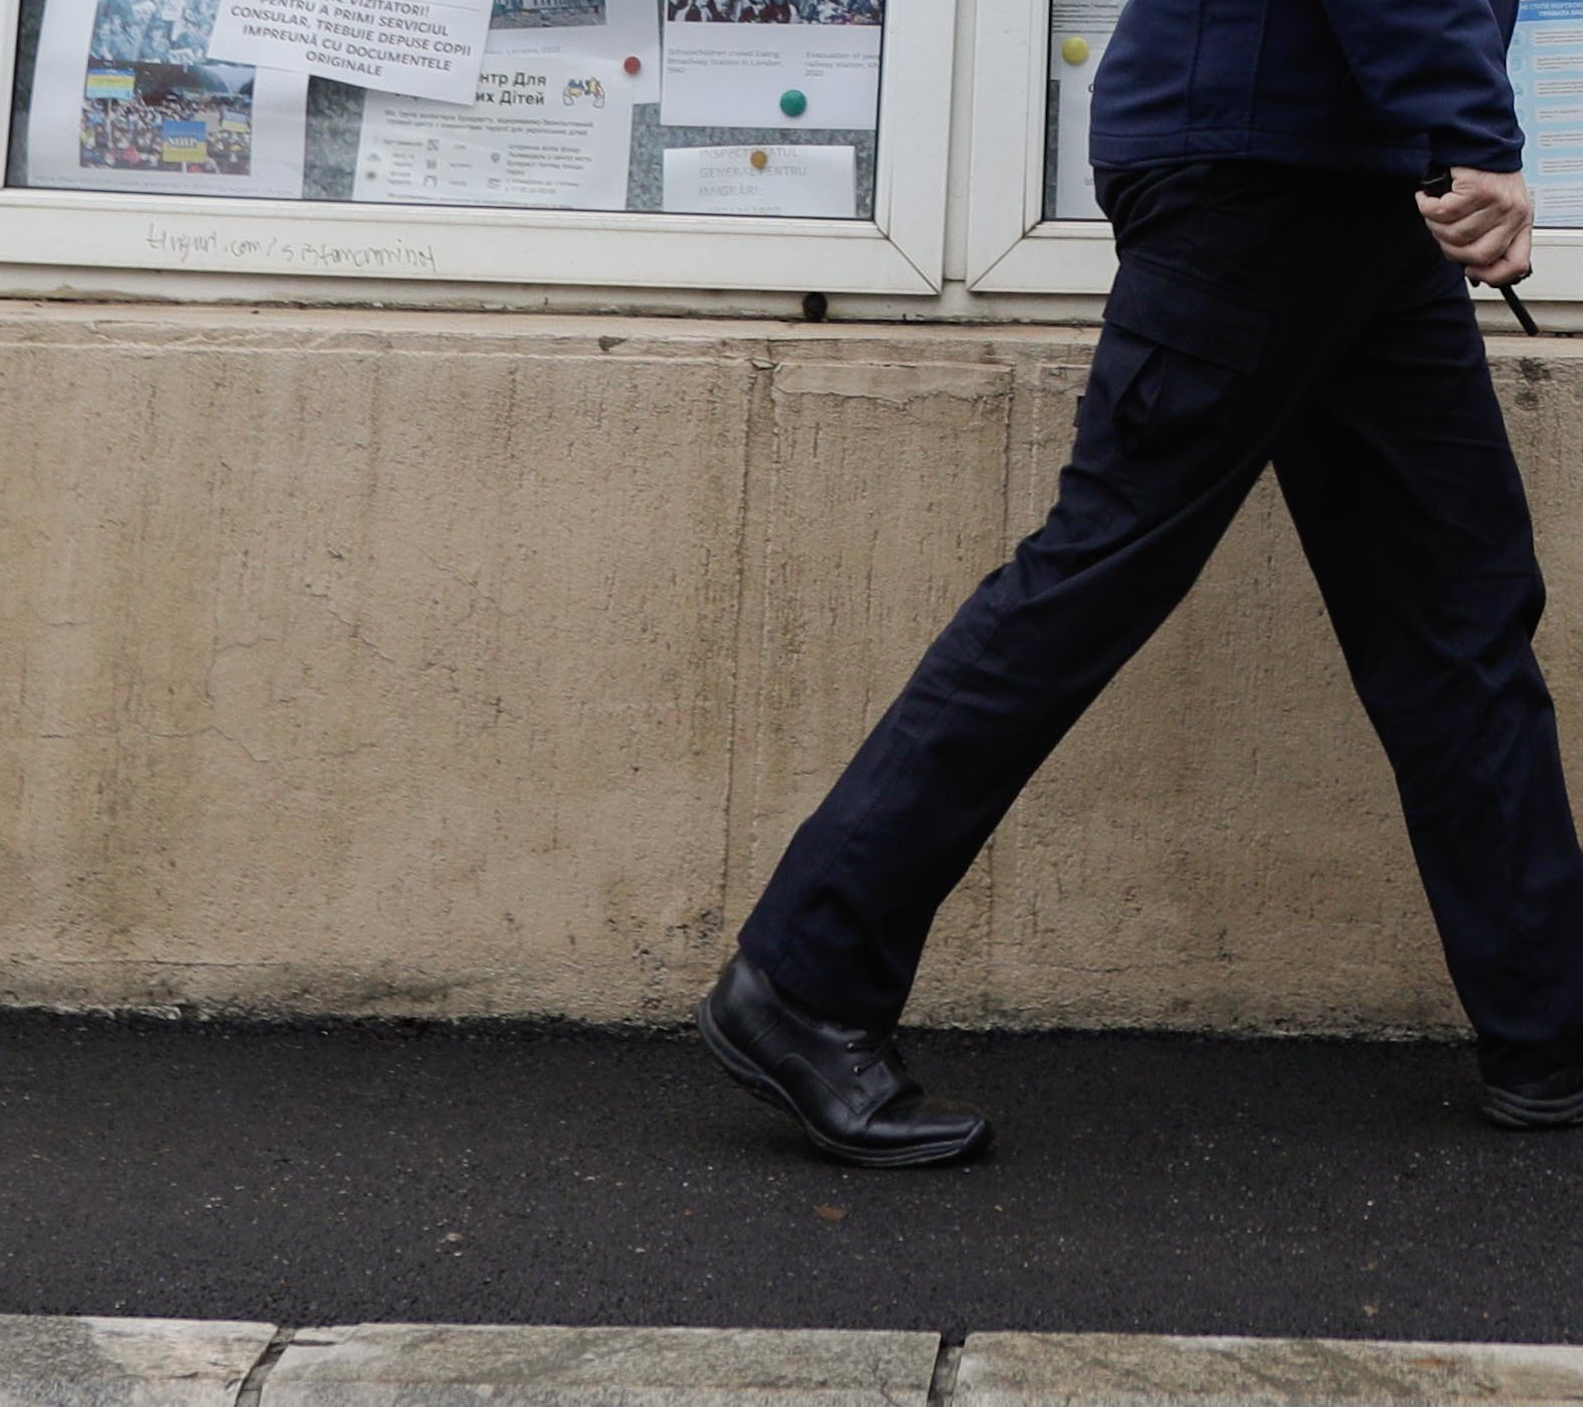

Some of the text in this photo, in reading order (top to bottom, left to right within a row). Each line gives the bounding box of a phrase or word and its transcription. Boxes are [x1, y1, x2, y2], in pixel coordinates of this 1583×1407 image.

[231, 5, 311, 29] CONSULAR,
[317, 19, 375, 40] TREBUIE
[378, 30, 430, 50] DEPUSE
[433, 41, 471, 57] COPII
[319, 4, 330, 15] A
[334, 9, 375, 25] PRIMI
[378, 16, 449, 37] SERVICIUL
[306, 50, 383, 78] ORIGINALE
[321, 37, 342, 52] CU
[345, 43, 452, 72] DOCUMENTELE
[479, 72, 547, 91] нтр Для
[500, 90, 545, 107] Дітей
